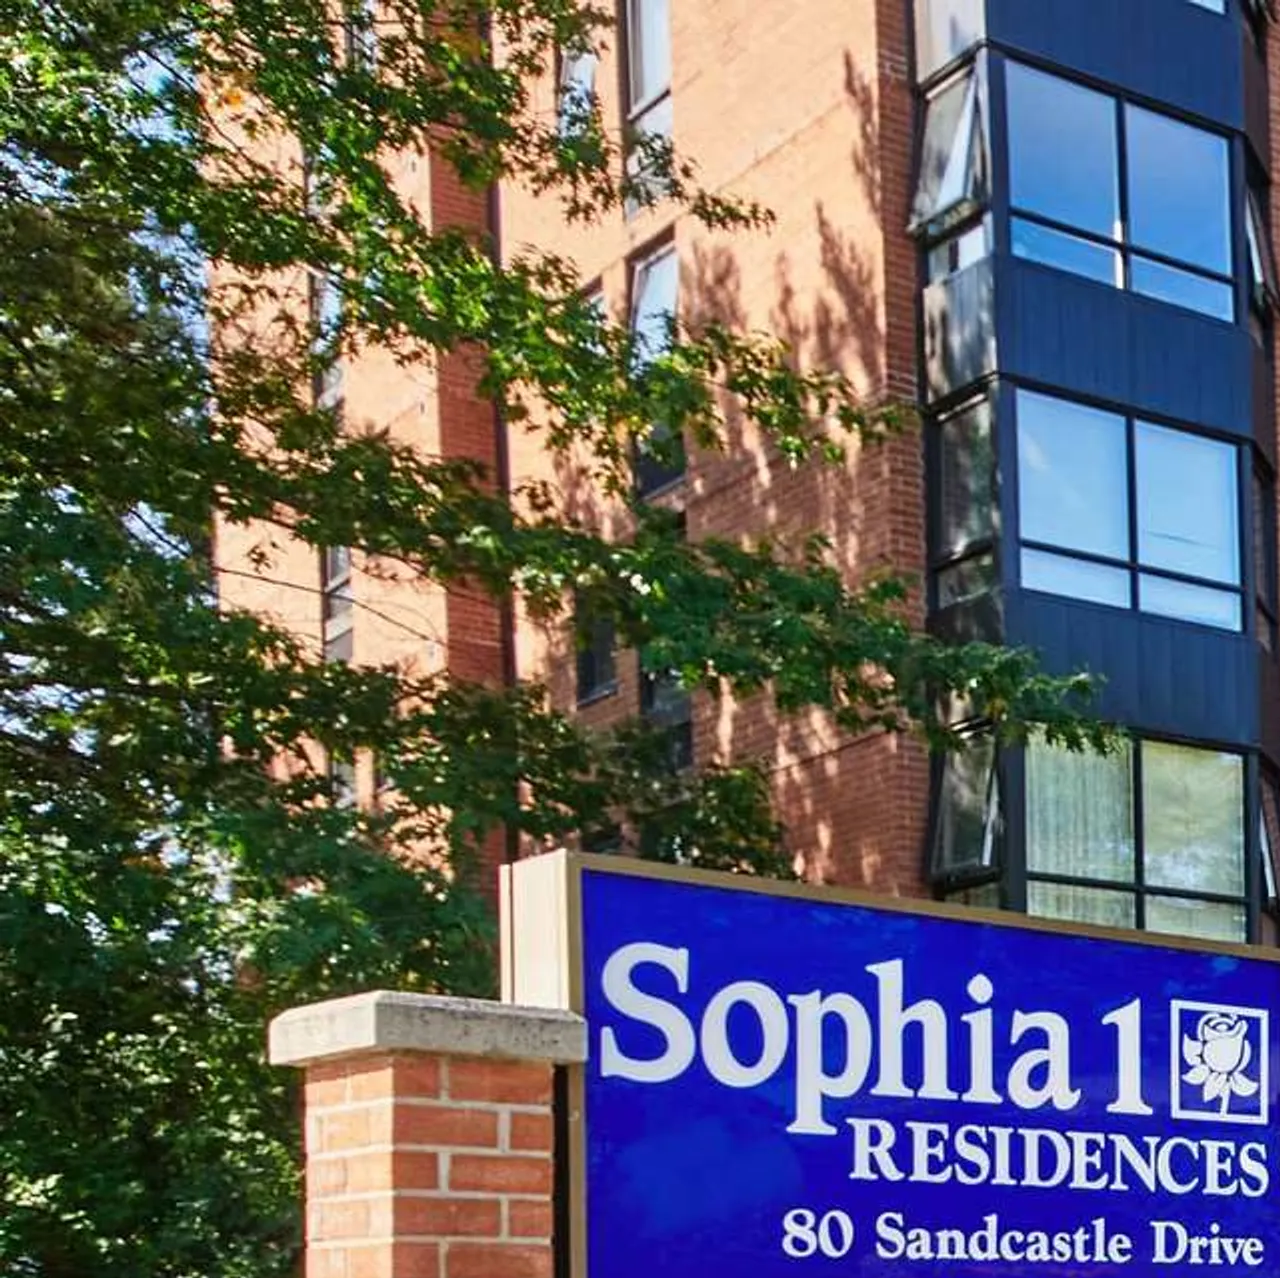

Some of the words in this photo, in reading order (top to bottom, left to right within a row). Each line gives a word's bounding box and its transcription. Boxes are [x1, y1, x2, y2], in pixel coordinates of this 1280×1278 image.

[601, 942, 1081, 1135] Sophia
[1101, 998, 1154, 1116] 1
[845, 1117, 1269, 1197] RESIDENCES
[782, 1208, 854, 1258] 80
[875, 1211, 1132, 1264] Sandcastle
[1149, 1221, 1264, 1266] Drive
